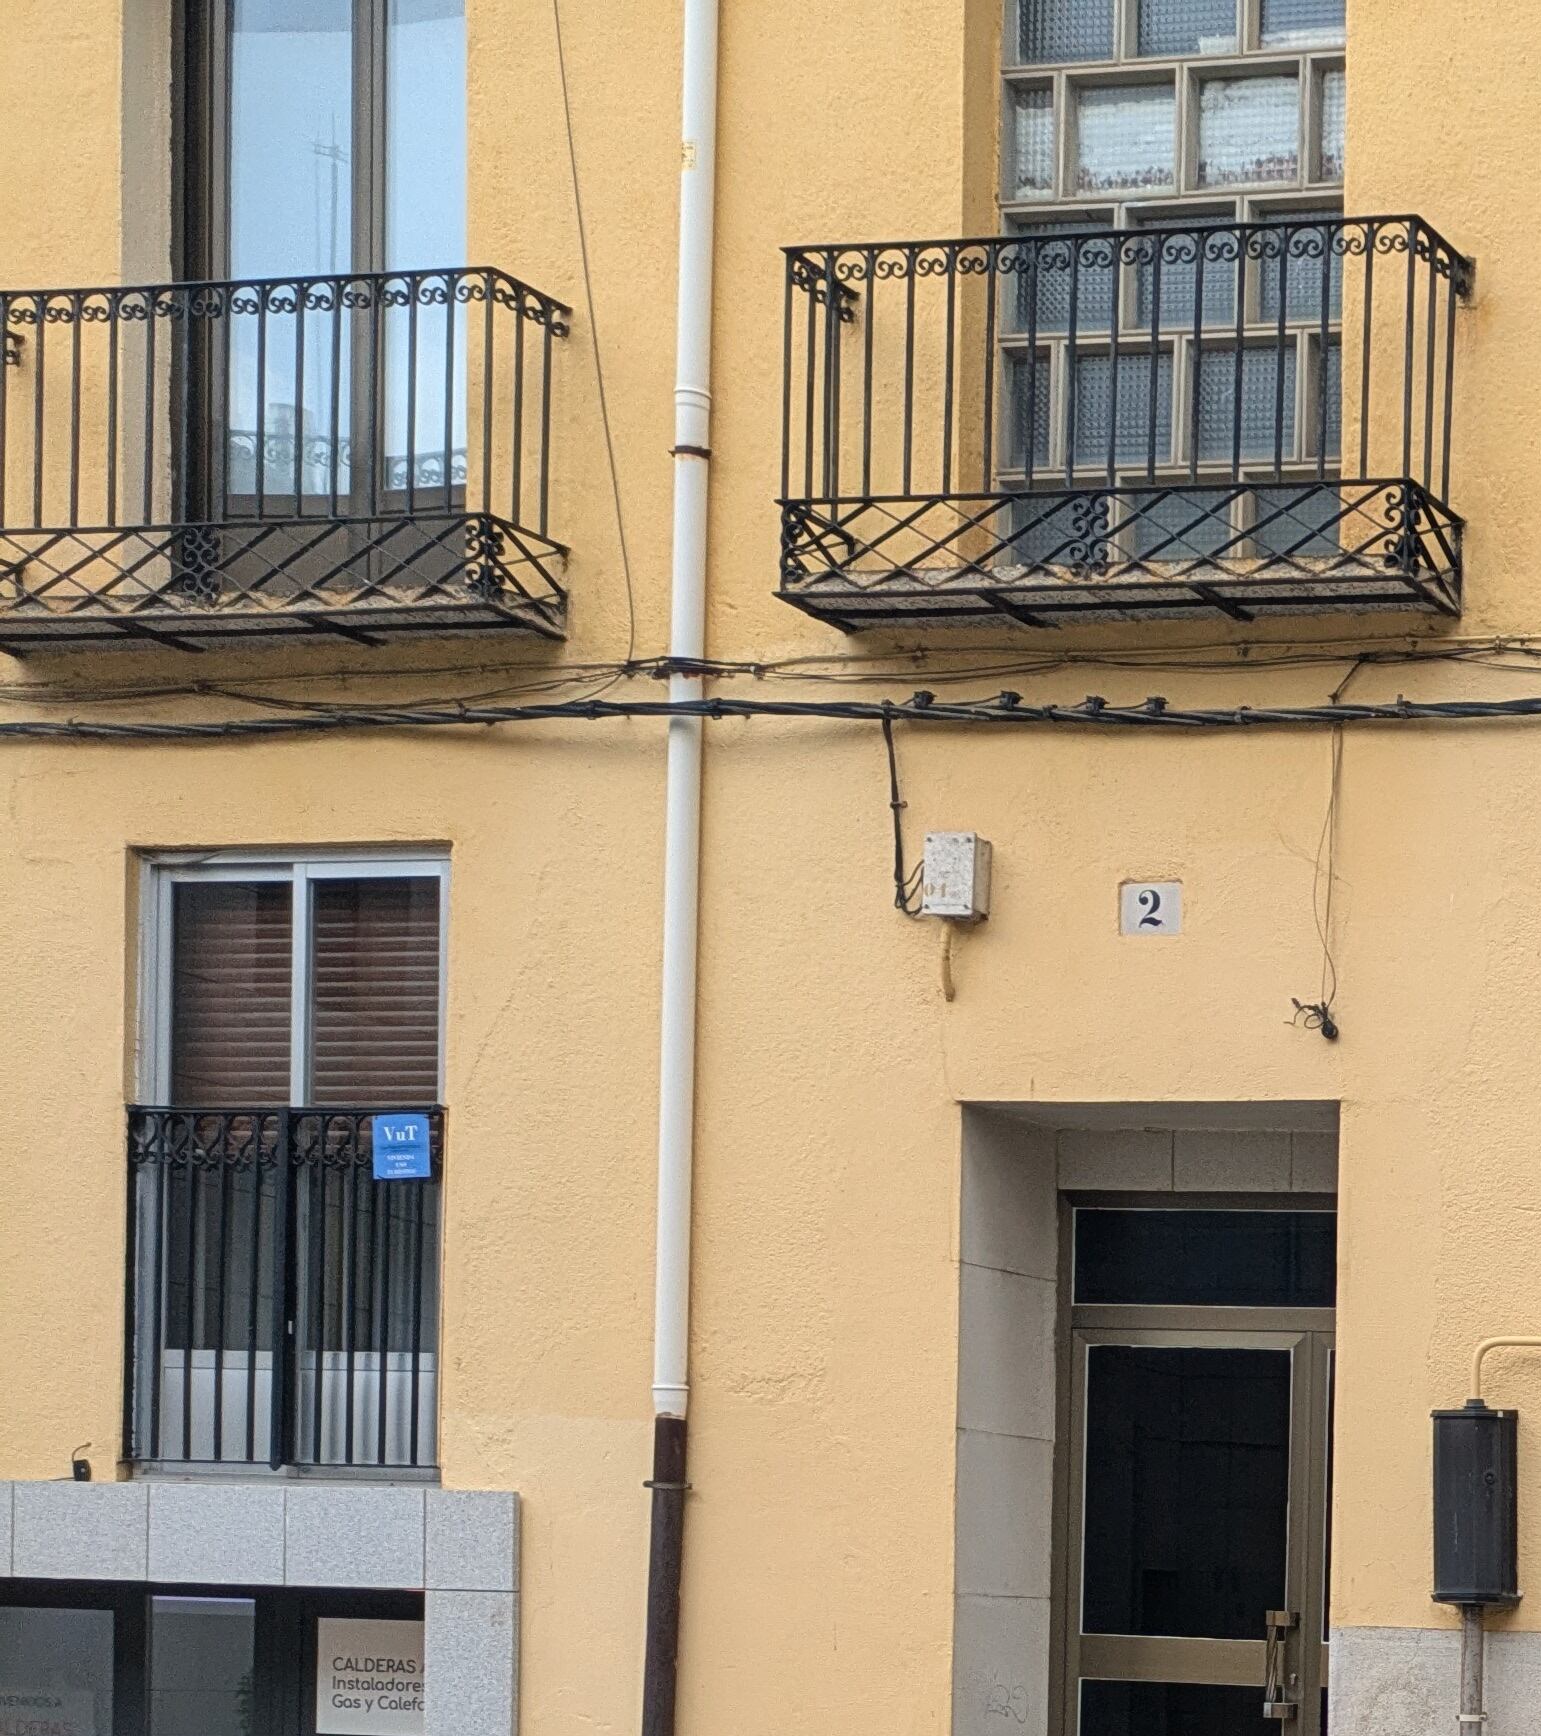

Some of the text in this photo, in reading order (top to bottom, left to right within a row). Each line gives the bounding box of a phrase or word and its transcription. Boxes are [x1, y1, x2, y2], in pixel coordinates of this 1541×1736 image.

[1138, 889, 1163, 928] 2
[383, 1125, 418, 1141] VuT
[332, 1657, 416, 1673] CALDERAS
[332, 1693, 361, 1709] Gas
[364, 1698, 374, 1713] y
